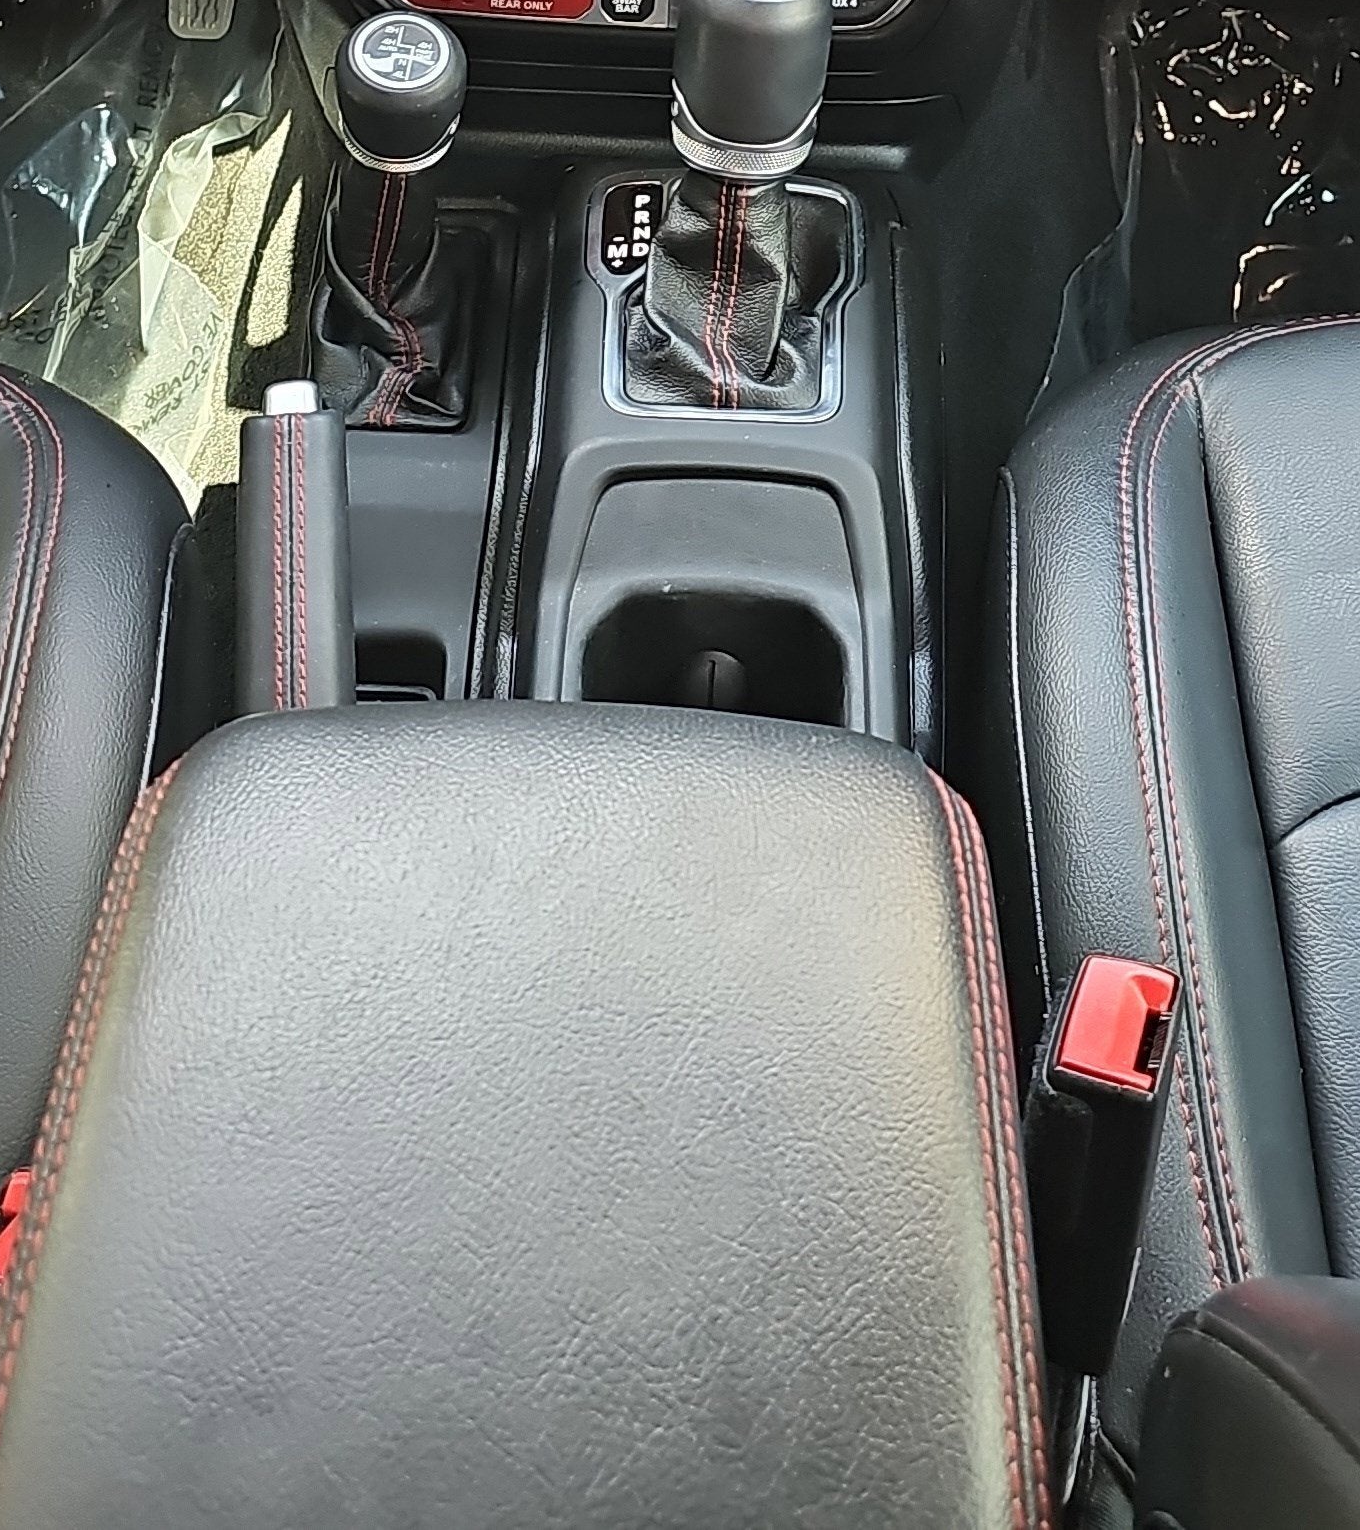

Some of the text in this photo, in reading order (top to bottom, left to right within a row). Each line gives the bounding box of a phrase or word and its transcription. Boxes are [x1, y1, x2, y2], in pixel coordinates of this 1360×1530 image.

[523, 0, 554, 11] ONLY
[614, 3, 640, 14] BAR
[634, 194, 651, 209] P
[633, 210, 650, 224] R
[633, 225, 651, 240] N
[607, 242, 650, 259] M D
